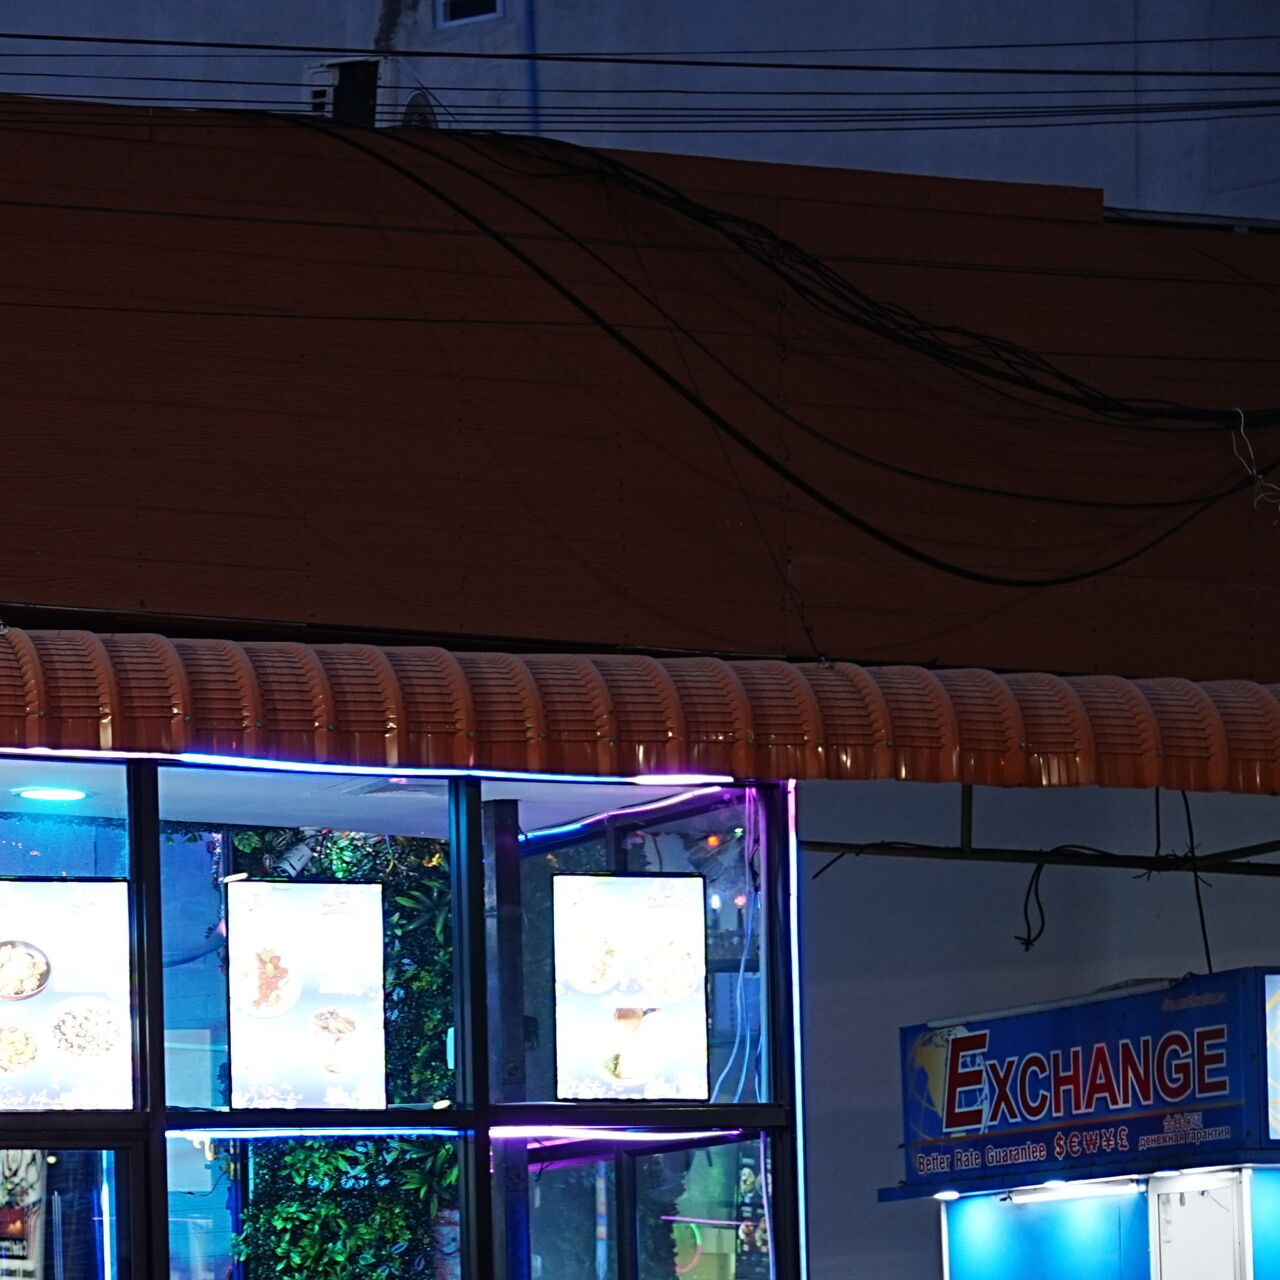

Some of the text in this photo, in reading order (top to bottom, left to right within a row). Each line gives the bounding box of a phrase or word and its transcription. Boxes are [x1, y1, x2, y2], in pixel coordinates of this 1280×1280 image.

[942, 1023, 1231, 1133] EXCHANGE
[917, 1145, 951, 1175] Better
[955, 1148, 982, 1170] Rate
[985, 1141, 1047, 1167] Guarantee
